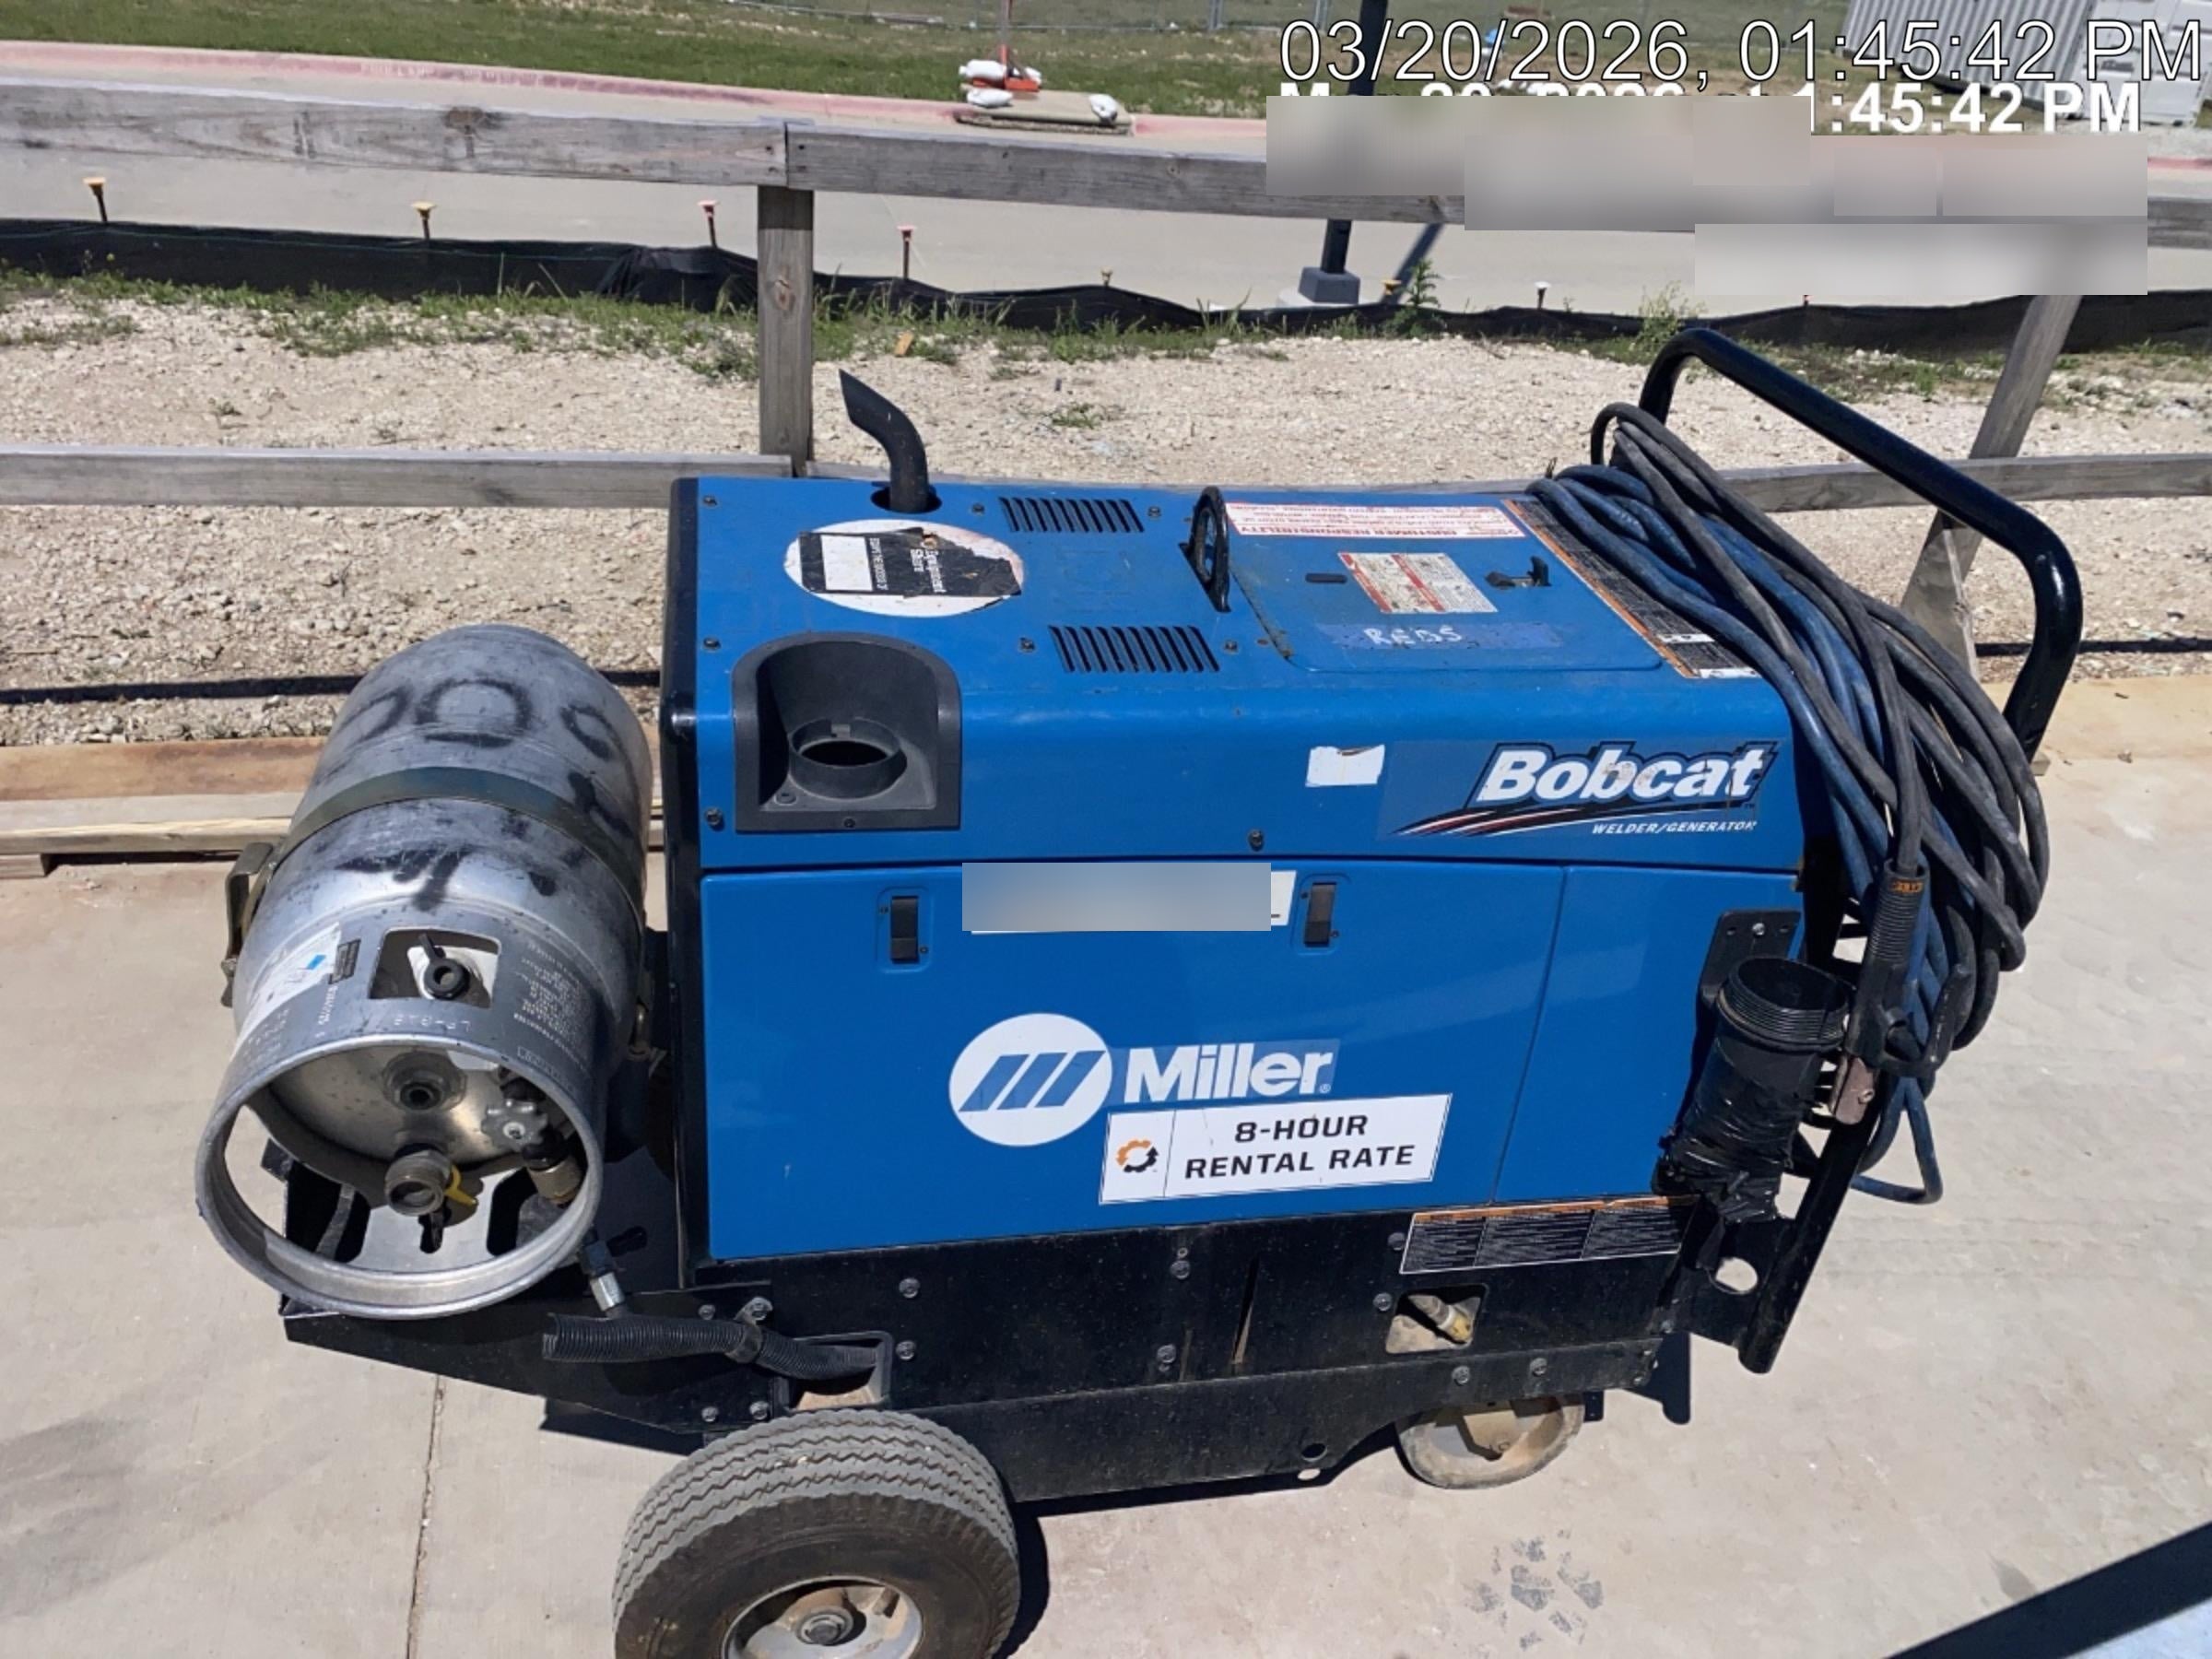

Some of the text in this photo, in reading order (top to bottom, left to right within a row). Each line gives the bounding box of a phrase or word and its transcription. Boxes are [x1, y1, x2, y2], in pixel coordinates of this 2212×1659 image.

[1476, 748, 1764, 802] Bobcat
[1591, 820, 1758, 834] WELDER/GENERATOR
[1124, 1043, 1334, 1104] Miller
[1234, 1114, 1369, 1144] 8-HOUR
[1185, 1144, 1416, 1180] RENTAL RATE
